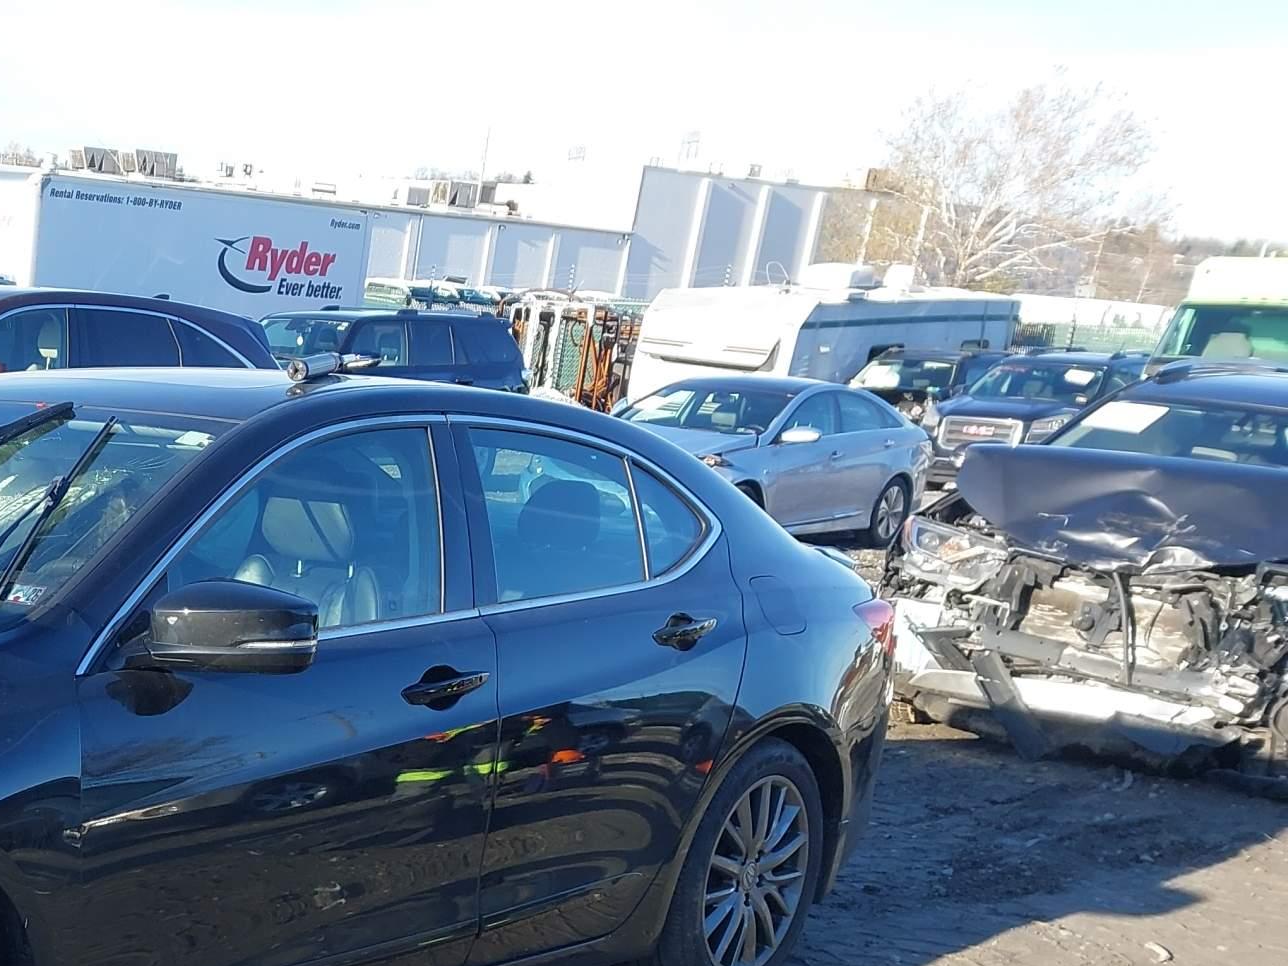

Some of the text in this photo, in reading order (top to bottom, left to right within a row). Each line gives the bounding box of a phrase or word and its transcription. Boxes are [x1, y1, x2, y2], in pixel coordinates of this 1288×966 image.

[50, 188, 73, 199] Rental
[329, 218, 361, 230] Ryder.com
[245, 235, 337, 281] Ryder
[277, 278, 306, 297] Ever
